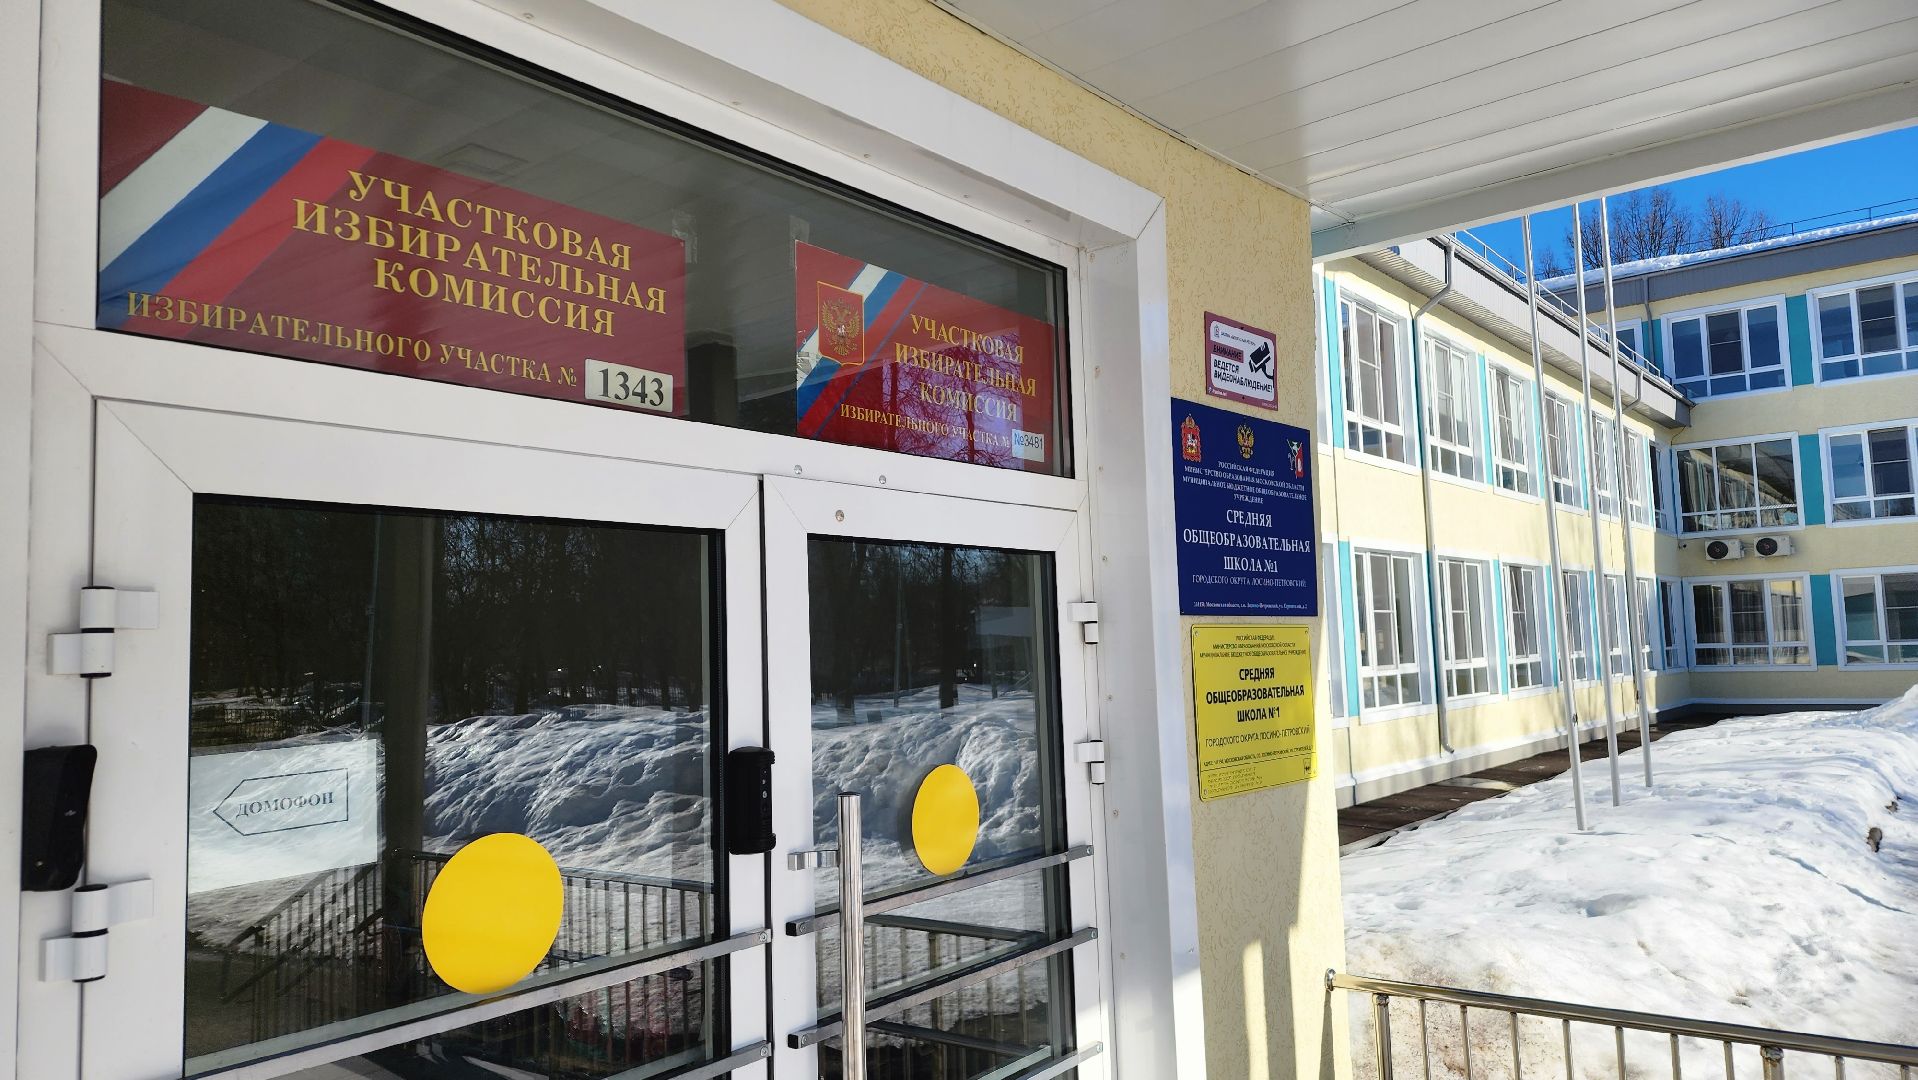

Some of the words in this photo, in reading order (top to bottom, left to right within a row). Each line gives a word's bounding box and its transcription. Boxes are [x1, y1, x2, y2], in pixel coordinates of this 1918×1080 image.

[348, 169, 631, 271] УЧАСТКОВАЯ
[292, 198, 667, 314] ИЗБИРАТЕЛЬНАЯ
[373, 257, 615, 337] КОМИССИЯ
[127, 291, 431, 362] ИЗБИРАТЕЛЬНОГО
[440, 343, 552, 383] УЧАСТКА
[558, 366, 577, 387] №
[598, 368, 664, 407] 1343
[910, 313, 1025, 365] УЧАСТКОВАЯ
[895, 342, 1037, 397] ИЗБИРАТЕЛЬНАЯ
[1213, 358, 1240, 374] ВЕДЕТСЯ
[1213, 369, 1273, 393] ВИДЕОНАБЛЮДЕНИЕ!
[919, 381, 1018, 422] КОМИССИЯ
[840, 403, 949, 437] ИЗБИРАТЕЛЬНОГО
[952, 426, 999, 447] УЧАСТКА
[1226, 509, 1273, 528] СРЕДНЯЯ
[1183, 528, 1311, 553] ОБЩЕОБРАЗОВАТЕЛЬНАЯ
[1223, 556, 1264, 572] ШКОЛА
[1264, 559, 1278, 573] №1
[1192, 574, 1229, 585] ГОРОДСКОГО
[1230, 576, 1251, 586] ОКРУГА
[1239, 667, 1275, 682] СРЕДНЯЯ
[1206, 685, 1305, 705] ОБЩЕОБРАЗОВАТЕЛЬНАЯ
[1237, 707, 1267, 722] ШКОЛА
[1205, 736, 1240, 748] ГОРОДСКОГО
[1241, 732, 1259, 743] ОКРУГА
[1259, 724, 1310, 741] ЛОСИНО-ПЕТРОВСКИЙ
[235, 791, 334, 820] ДОМОФОН
